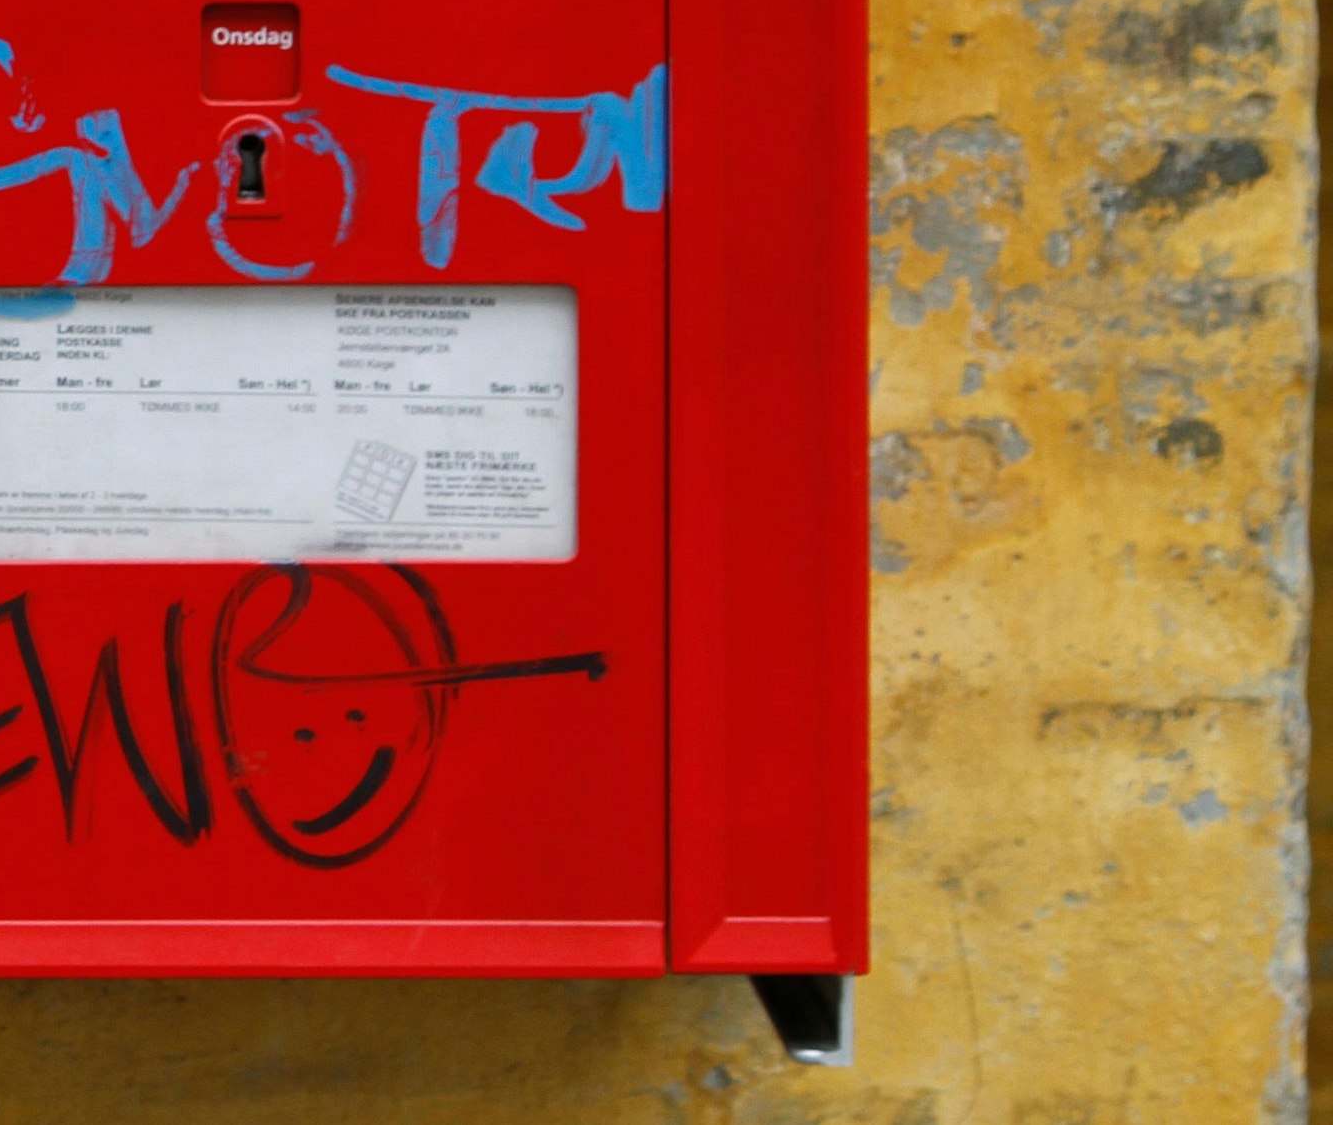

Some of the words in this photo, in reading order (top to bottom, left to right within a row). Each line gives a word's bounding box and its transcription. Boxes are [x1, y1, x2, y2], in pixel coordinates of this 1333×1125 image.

[212, 25, 293, 50] Onsdag
[57, 377, 83, 387] Man
[96, 377, 112, 387] fre
